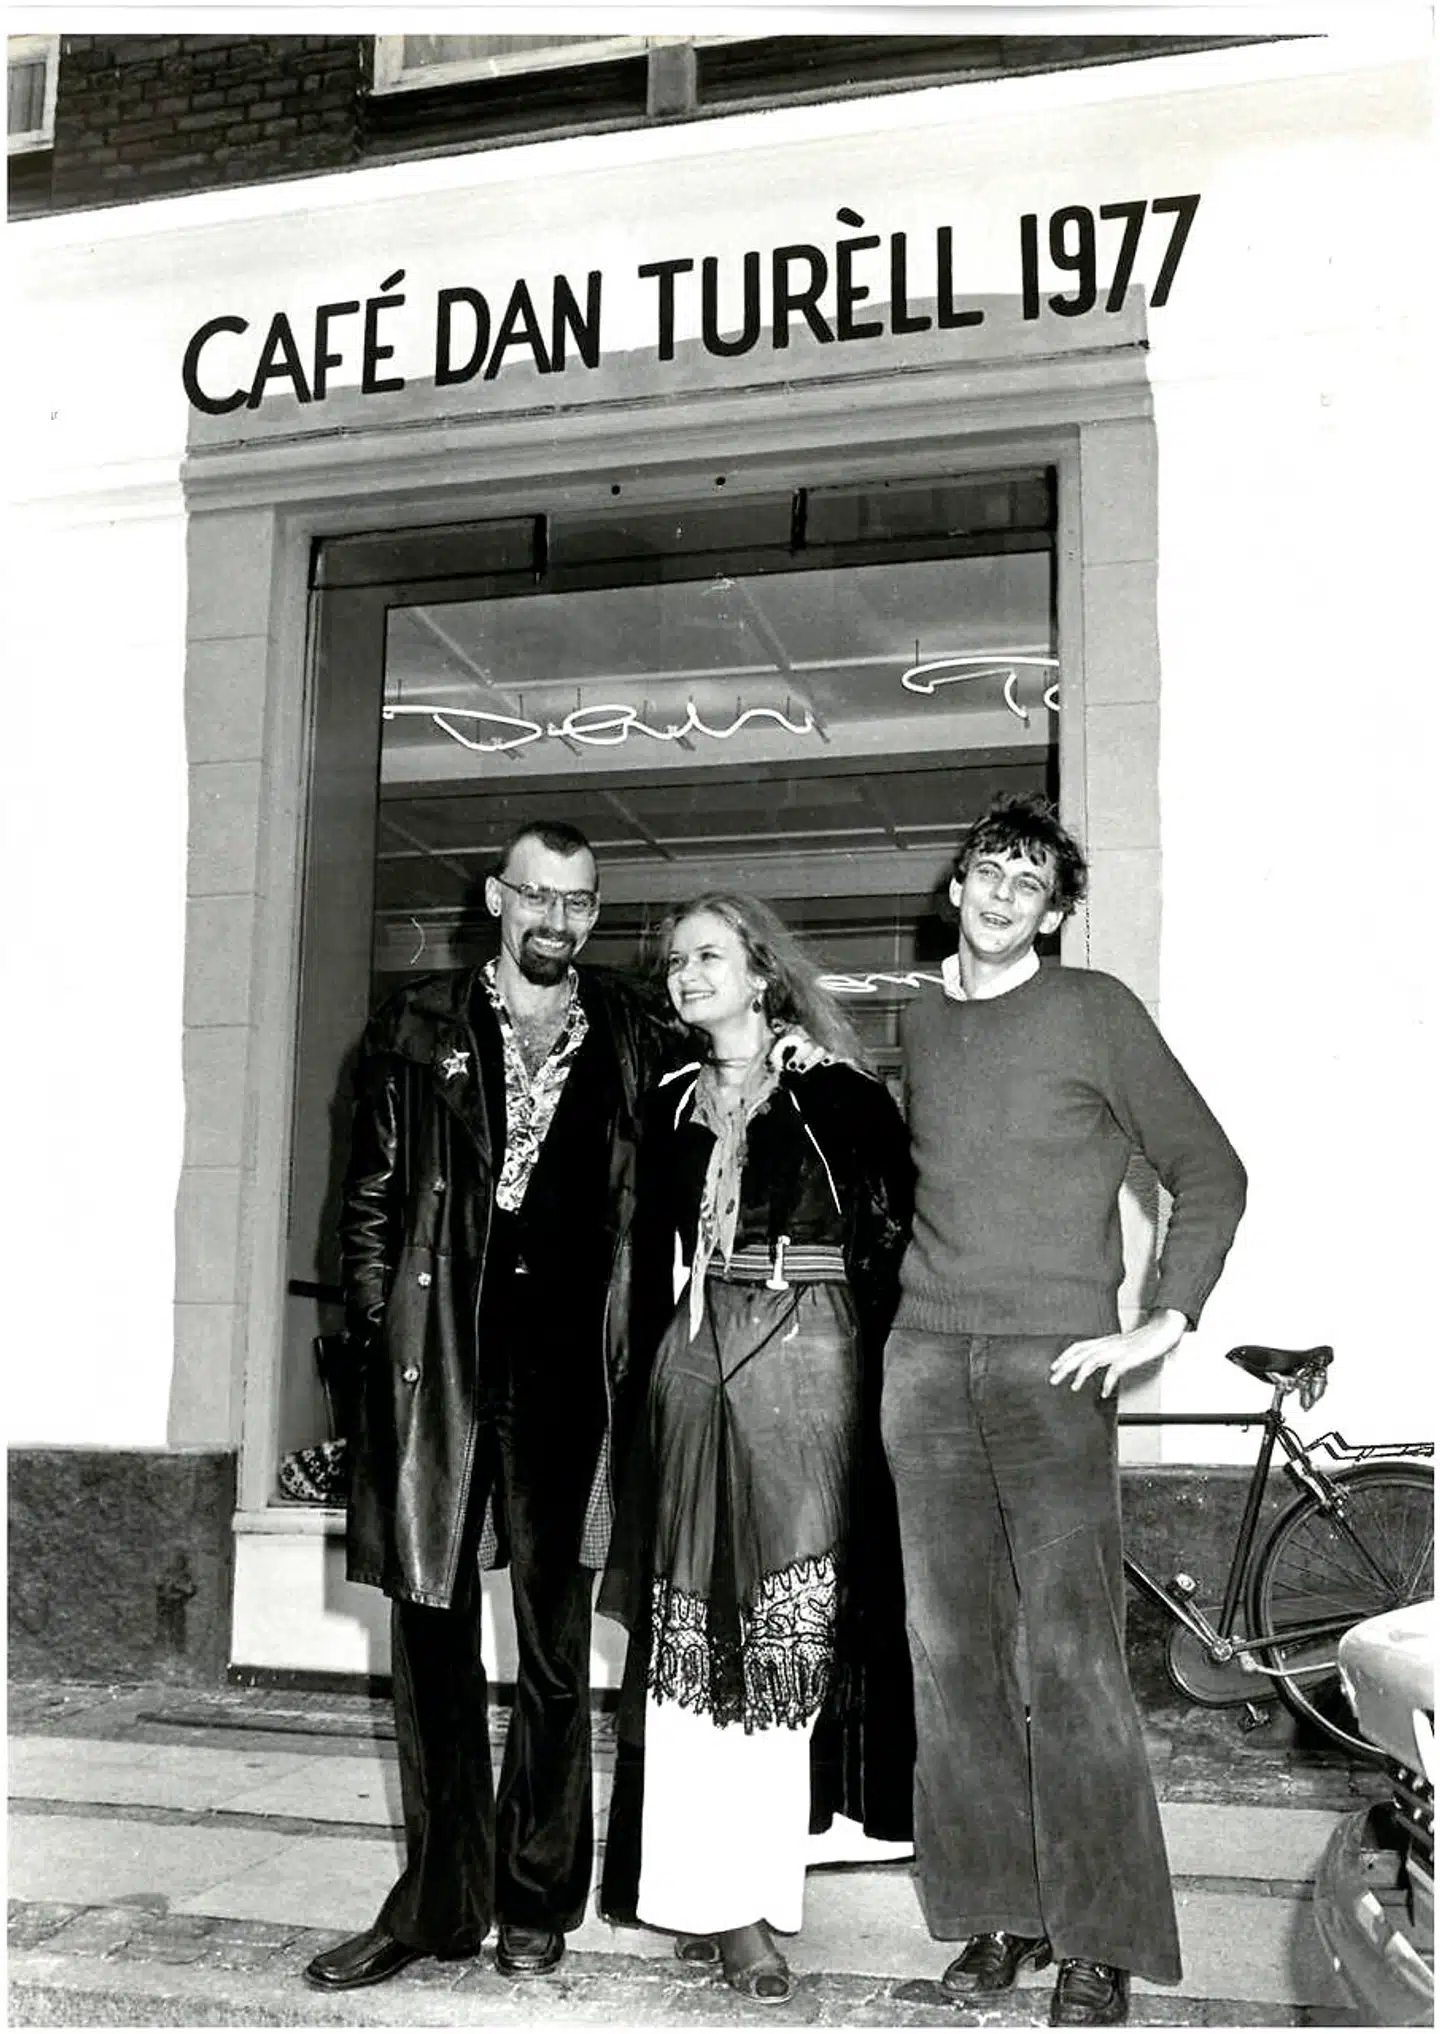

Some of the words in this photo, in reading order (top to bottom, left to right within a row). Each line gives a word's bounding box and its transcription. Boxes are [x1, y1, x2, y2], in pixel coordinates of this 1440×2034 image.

[182, 268, 408, 416] CAFÉ
[434, 270, 602, 388] DAN
[638, 207, 985, 362] TURÈLL
[1020, 194, 1201, 321] 1977
